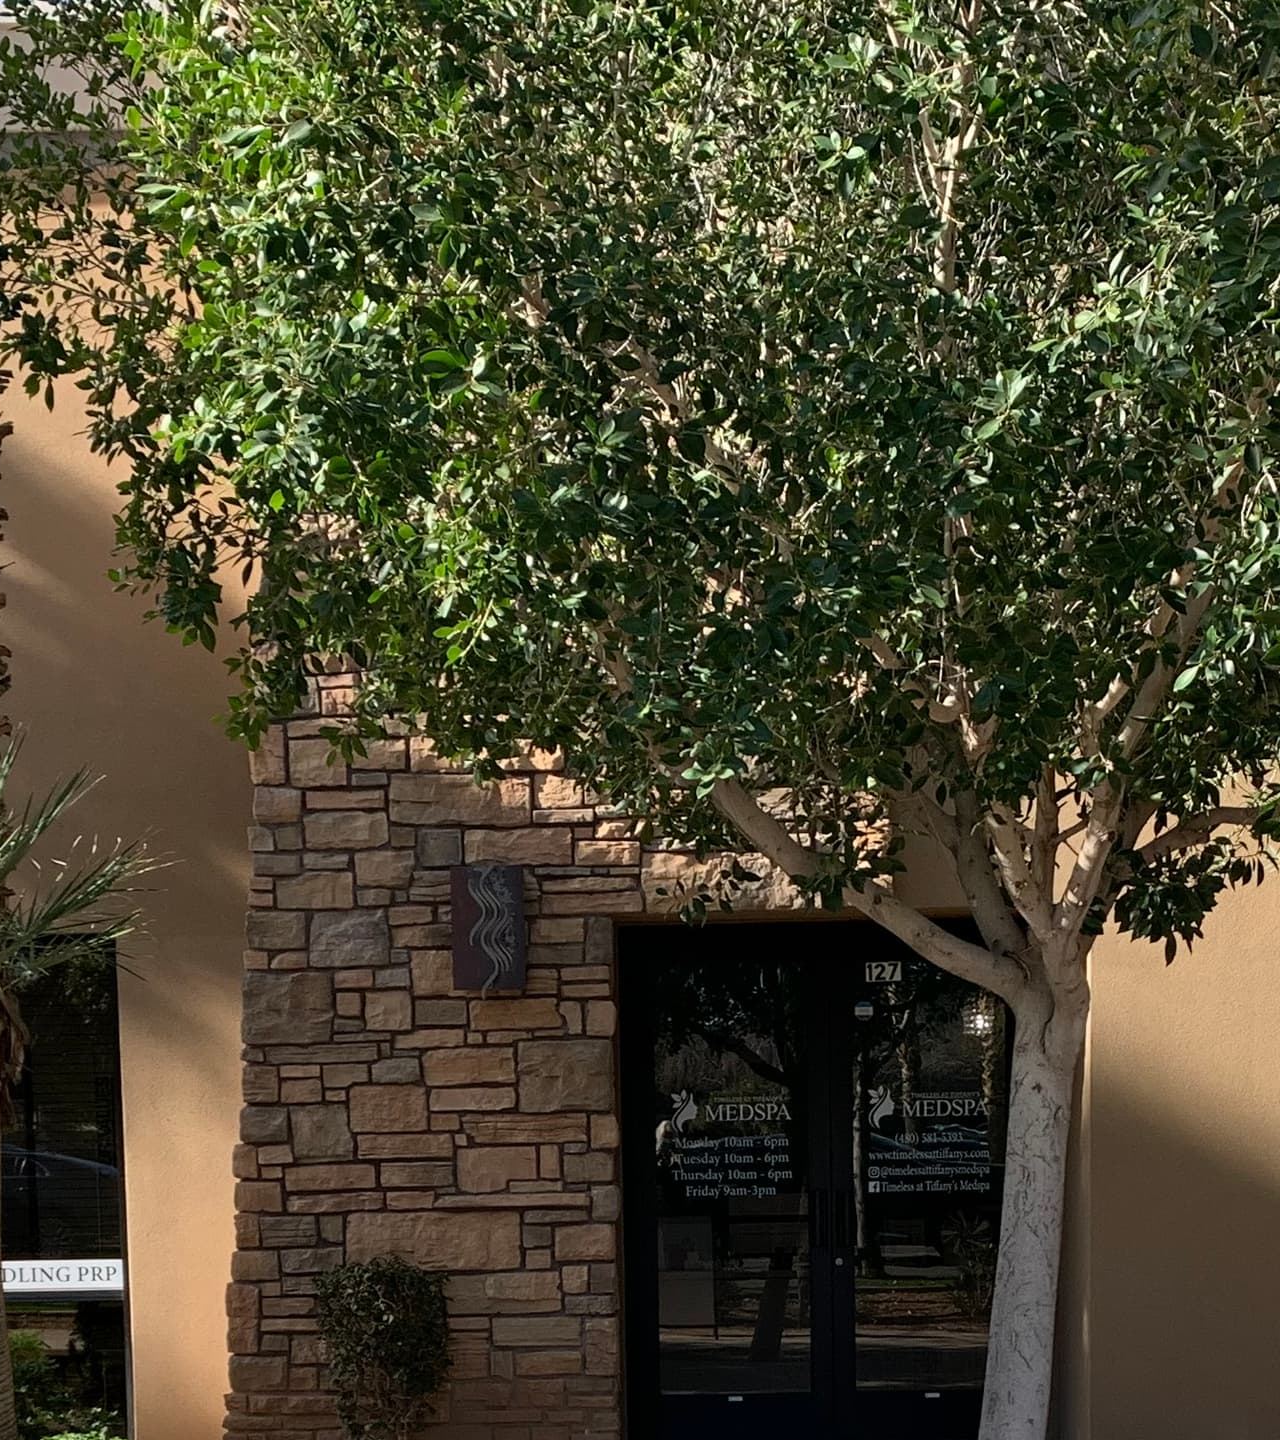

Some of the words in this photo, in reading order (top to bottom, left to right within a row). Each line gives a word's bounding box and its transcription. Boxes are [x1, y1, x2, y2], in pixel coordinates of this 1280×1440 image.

[867, 963, 898, 980] 127
[705, 1103, 792, 1121] MEDSPA
[903, 1099, 990, 1117] MEDSPA
[675, 1137, 723, 1150] Monday
[724, 1137, 754, 1147] 10am
[764, 1137, 789, 1149] 6pm
[673, 1153, 722, 1166] Tuesday
[724, 1154, 754, 1163] 10am
[764, 1154, 789, 1166] 6pm
[672, 1169, 724, 1182] Thursday
[728, 1170, 757, 1180] 10am
[768, 1169, 793, 1182] 6pm
[686, 1185, 721, 1199] Friday
[723, 1185, 777, 1198] 9am-3pm
[2, 1266, 71, 1283] DLING
[78, 1266, 117, 1282] PRP
